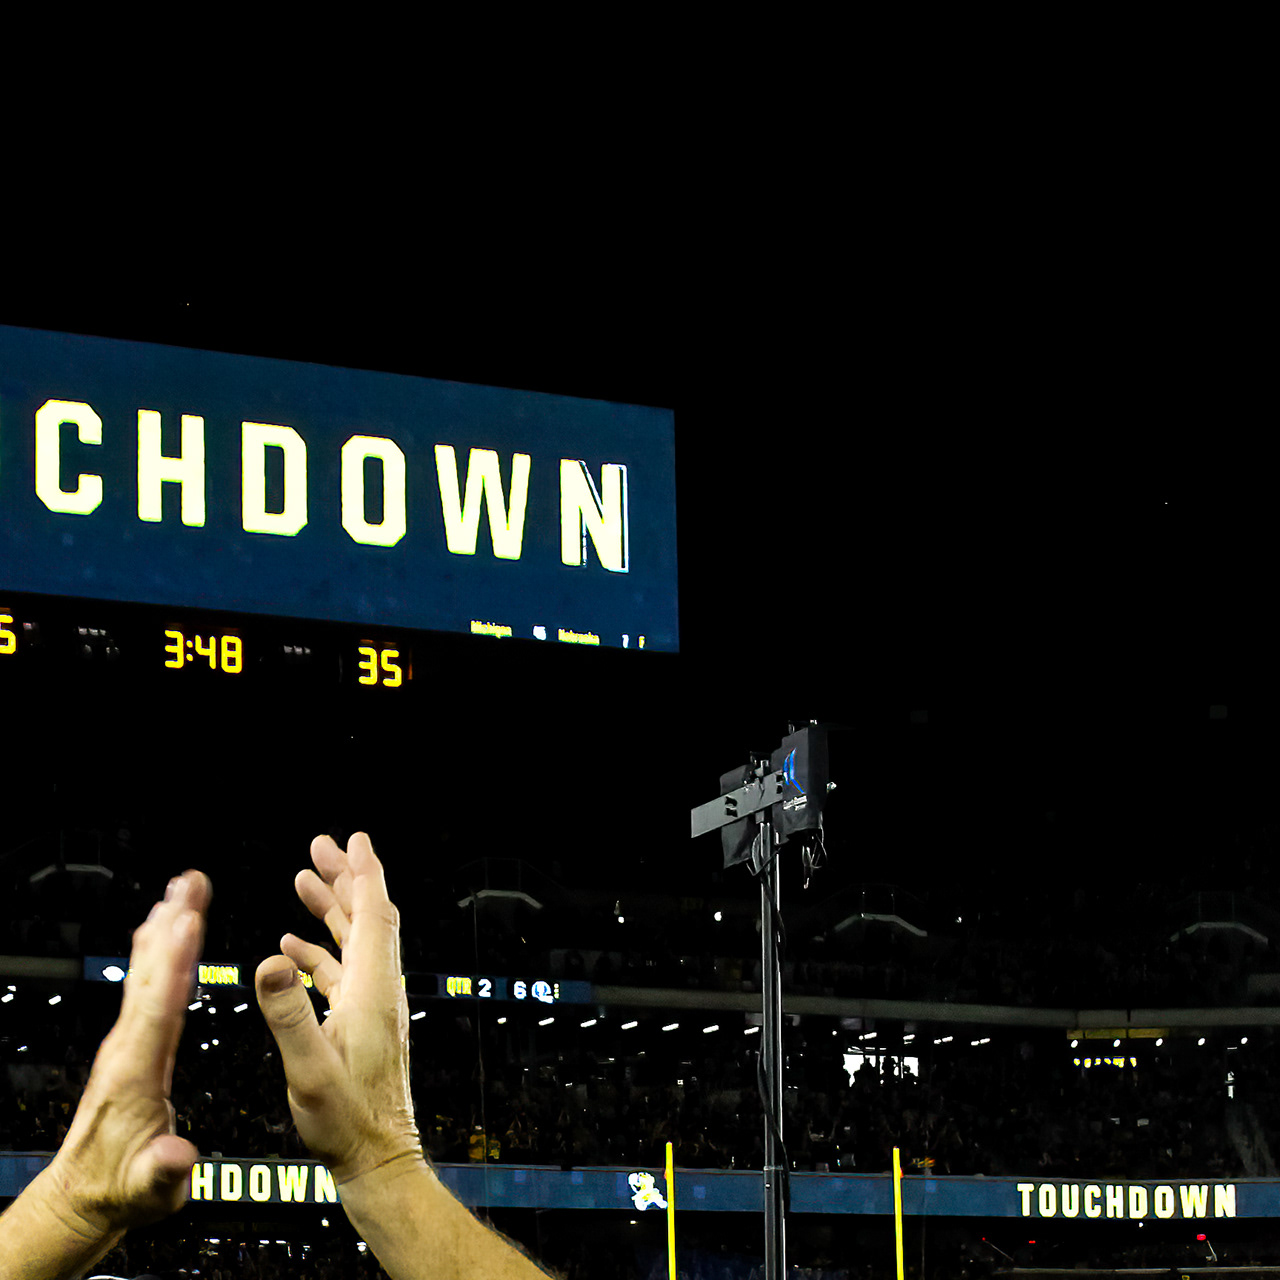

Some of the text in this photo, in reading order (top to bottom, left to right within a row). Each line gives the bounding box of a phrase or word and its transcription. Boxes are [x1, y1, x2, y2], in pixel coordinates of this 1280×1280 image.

[164, 629, 243, 673] 3:48
[358, 646, 403, 687] 35
[477, 978, 492, 997] 2
[191, 1152, 337, 1203] HDOWN
[1017, 1183, 1236, 1218] TOUCHDOWN
